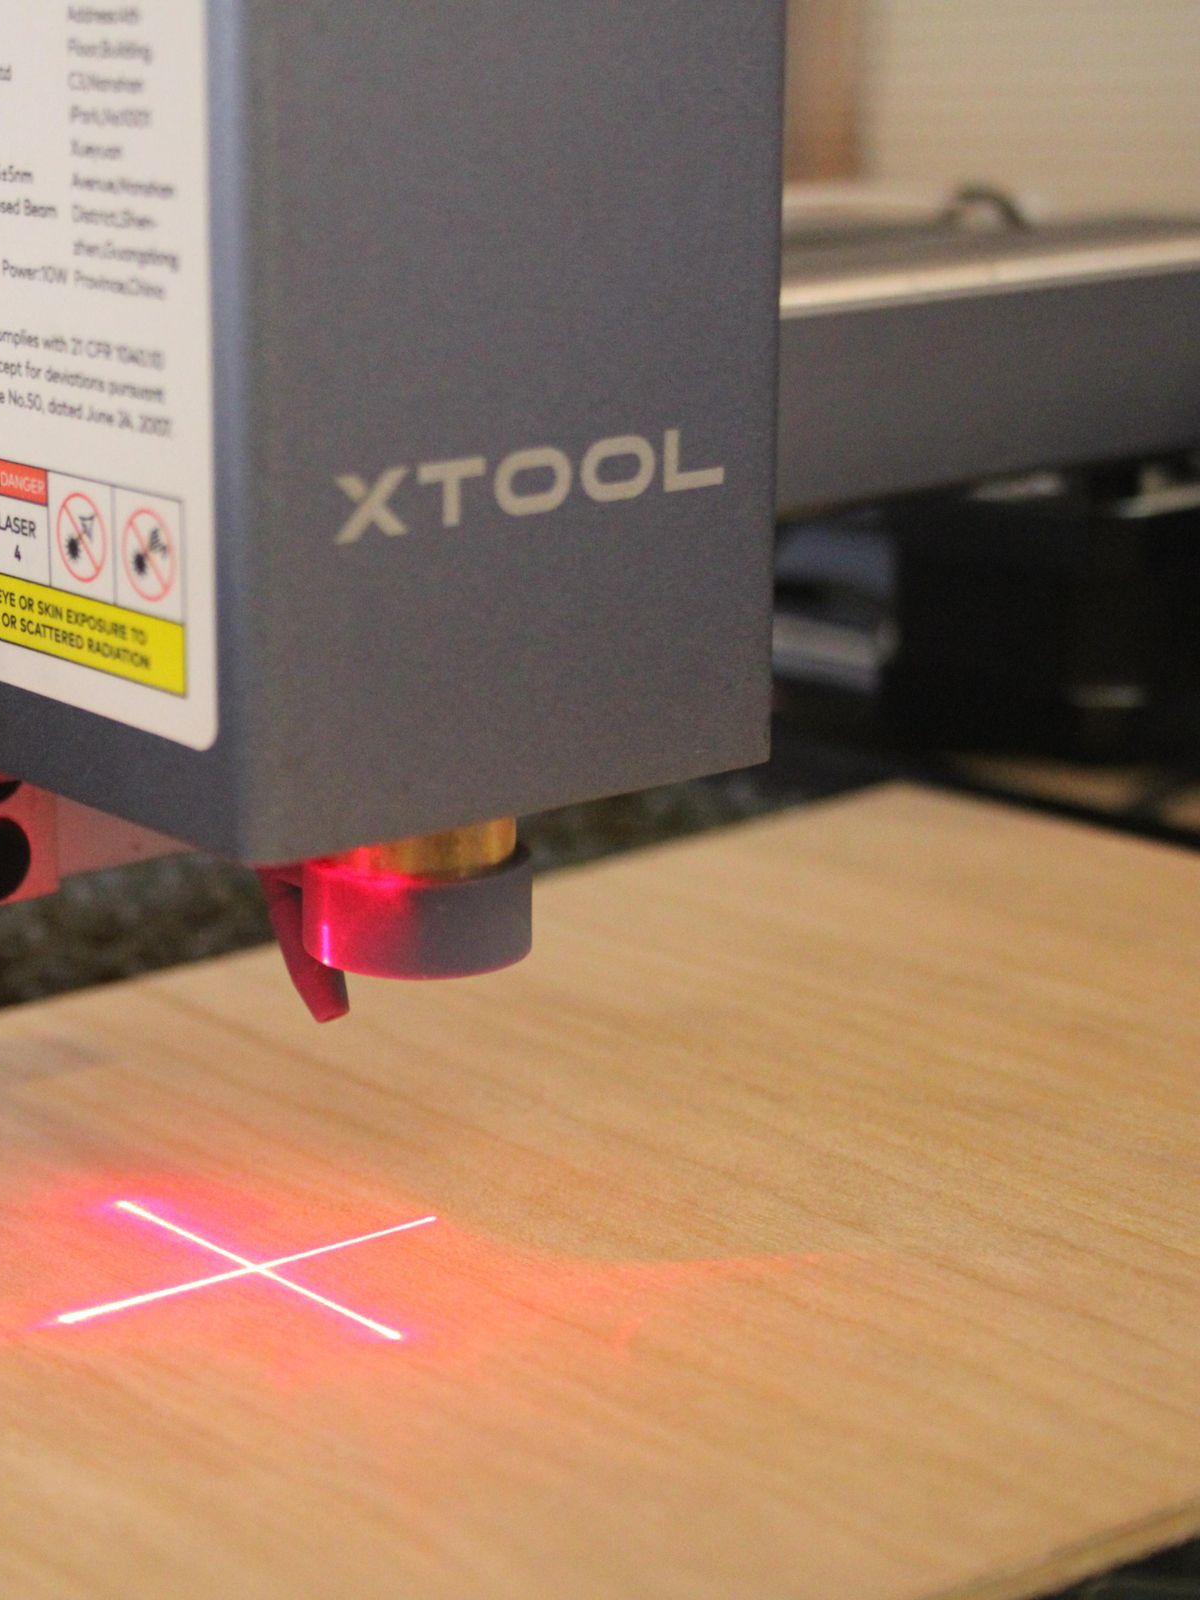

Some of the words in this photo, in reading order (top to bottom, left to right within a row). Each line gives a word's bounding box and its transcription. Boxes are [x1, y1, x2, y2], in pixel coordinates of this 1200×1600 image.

[23, 198, 58, 218] Beam
[42, 335, 67, 353] with
[70, 337, 82, 356] 21
[86, 339, 112, 360] CFR
[25, 360, 42, 379] for
[44, 366, 105, 392] deviations
[47, 398, 82, 420] dated
[86, 403, 114, 426] June
[0, 473, 45, 494] DANGER
[13, 545, 22, 561] 4
[19, 595, 35, 612] OR
[37, 600, 63, 622] SKIN
[66, 609, 128, 641] EXPOSURE
[130, 627, 148, 645] TO
[1, 612, 17, 629] OR
[20, 617, 84, 649] SCATTERED
[87, 639, 150, 669] RADIATION
